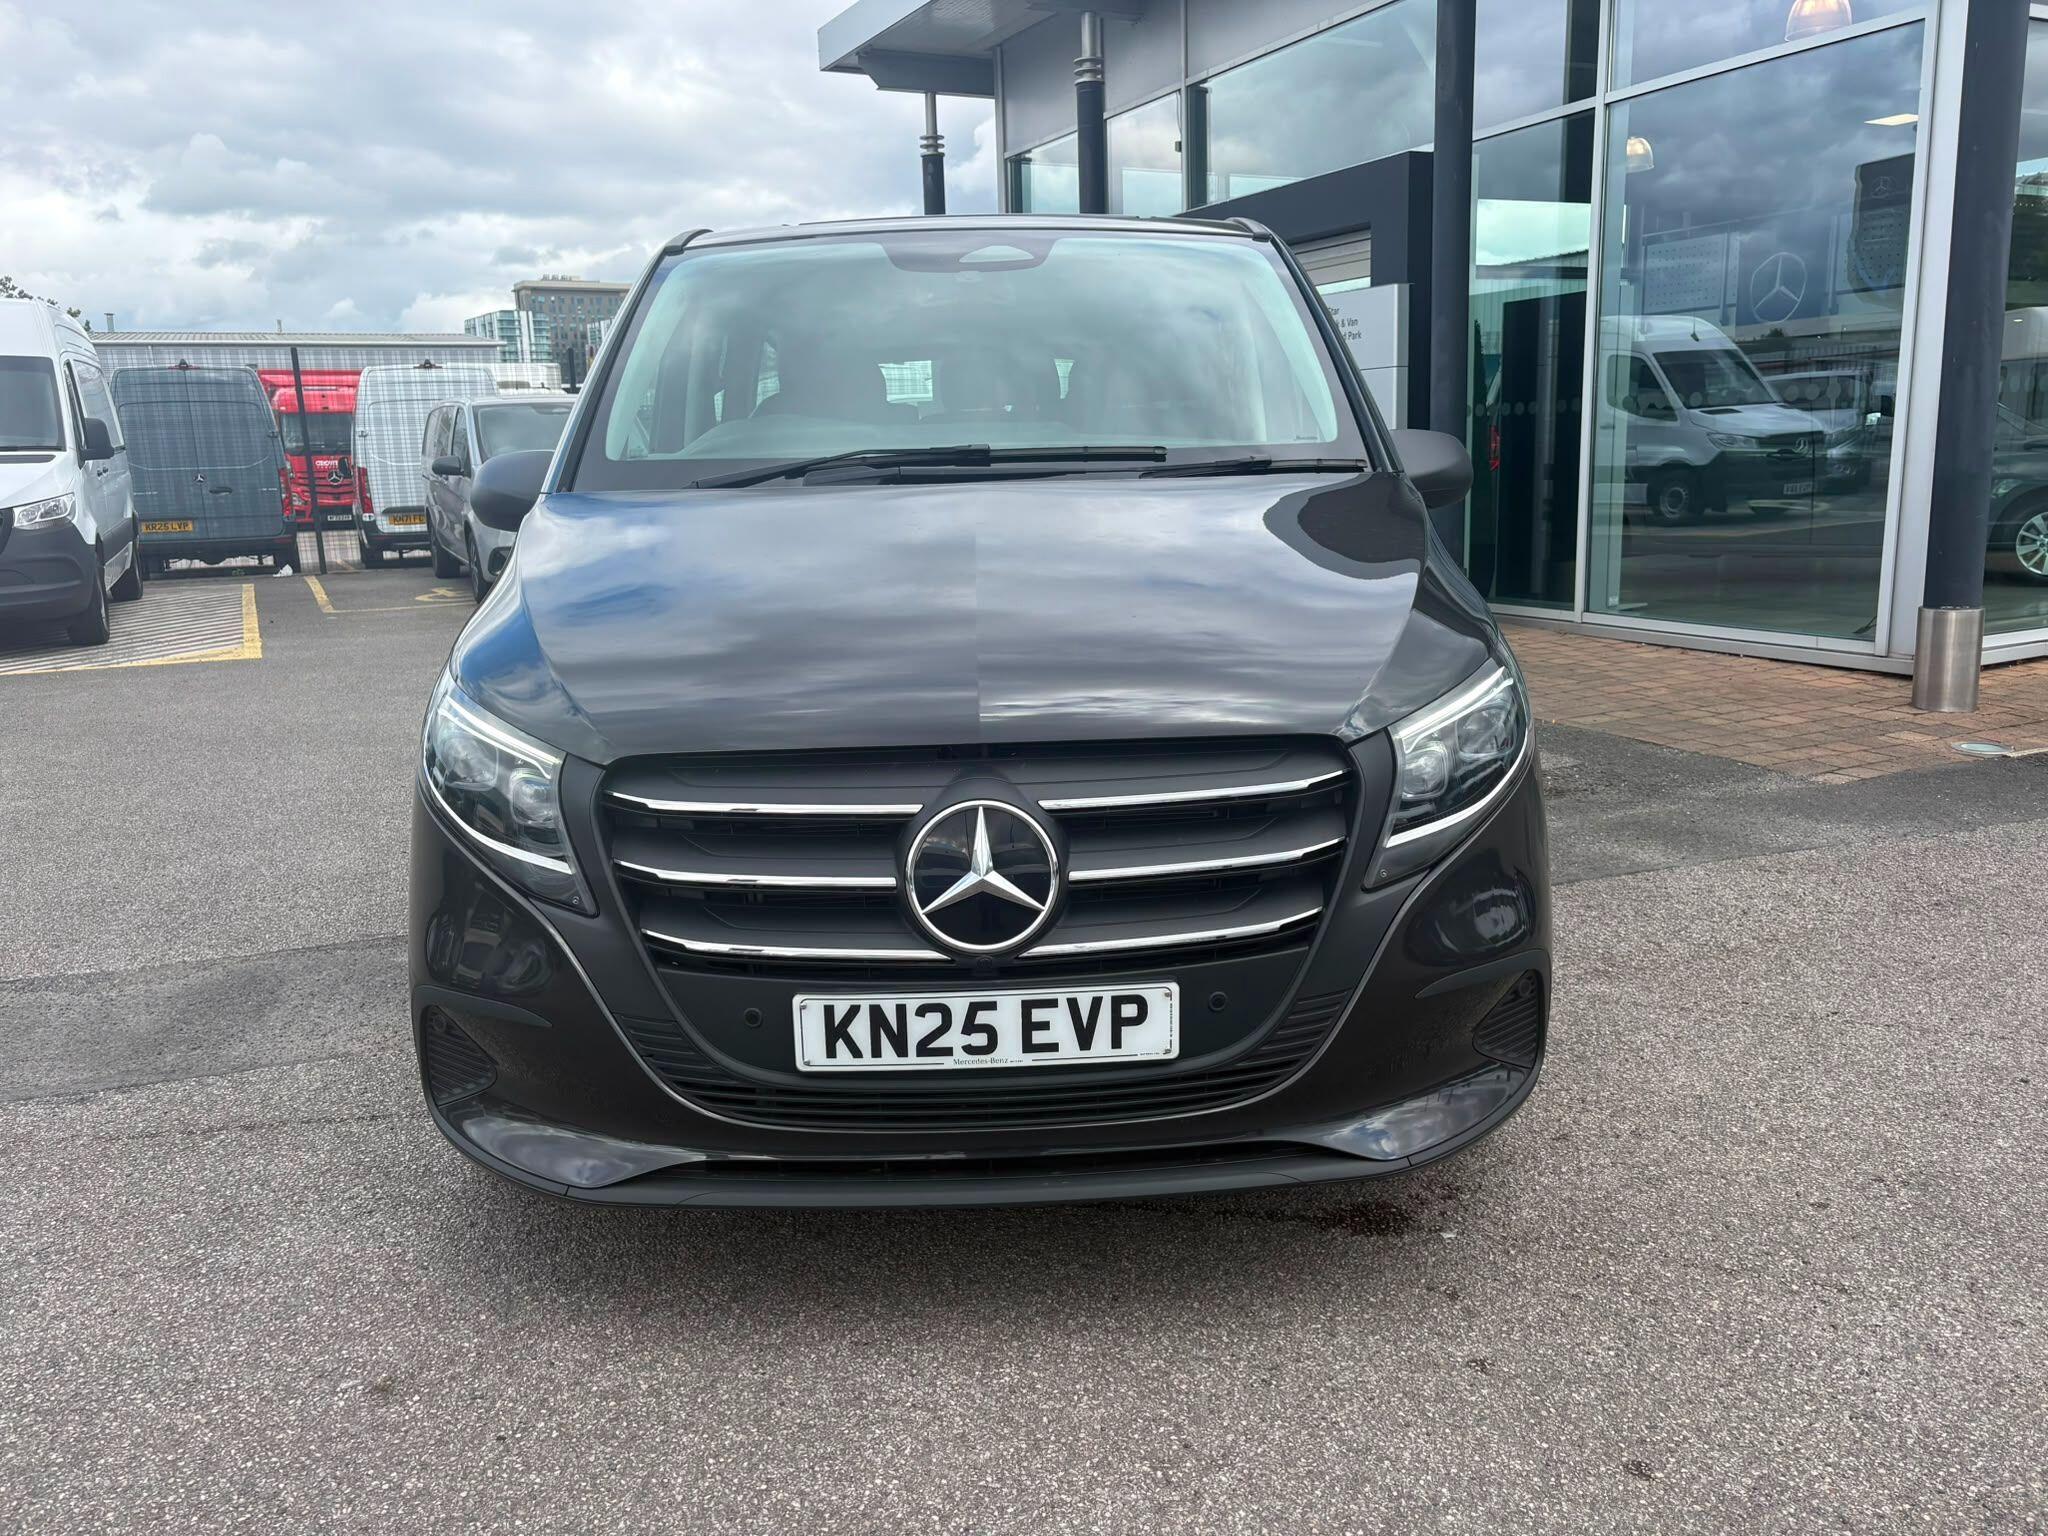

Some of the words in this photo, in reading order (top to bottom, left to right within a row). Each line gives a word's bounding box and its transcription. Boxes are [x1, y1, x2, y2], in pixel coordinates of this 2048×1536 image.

[1347, 317, 1359, 327] Van
[1348, 331, 1362, 340] Park
[144, 522, 170, 531] KR25
[823, 1000, 999, 1059] KN25
[1021, 994, 1149, 1054] EVP
[953, 1057, 1009, 1065] Mercedes-Benz
